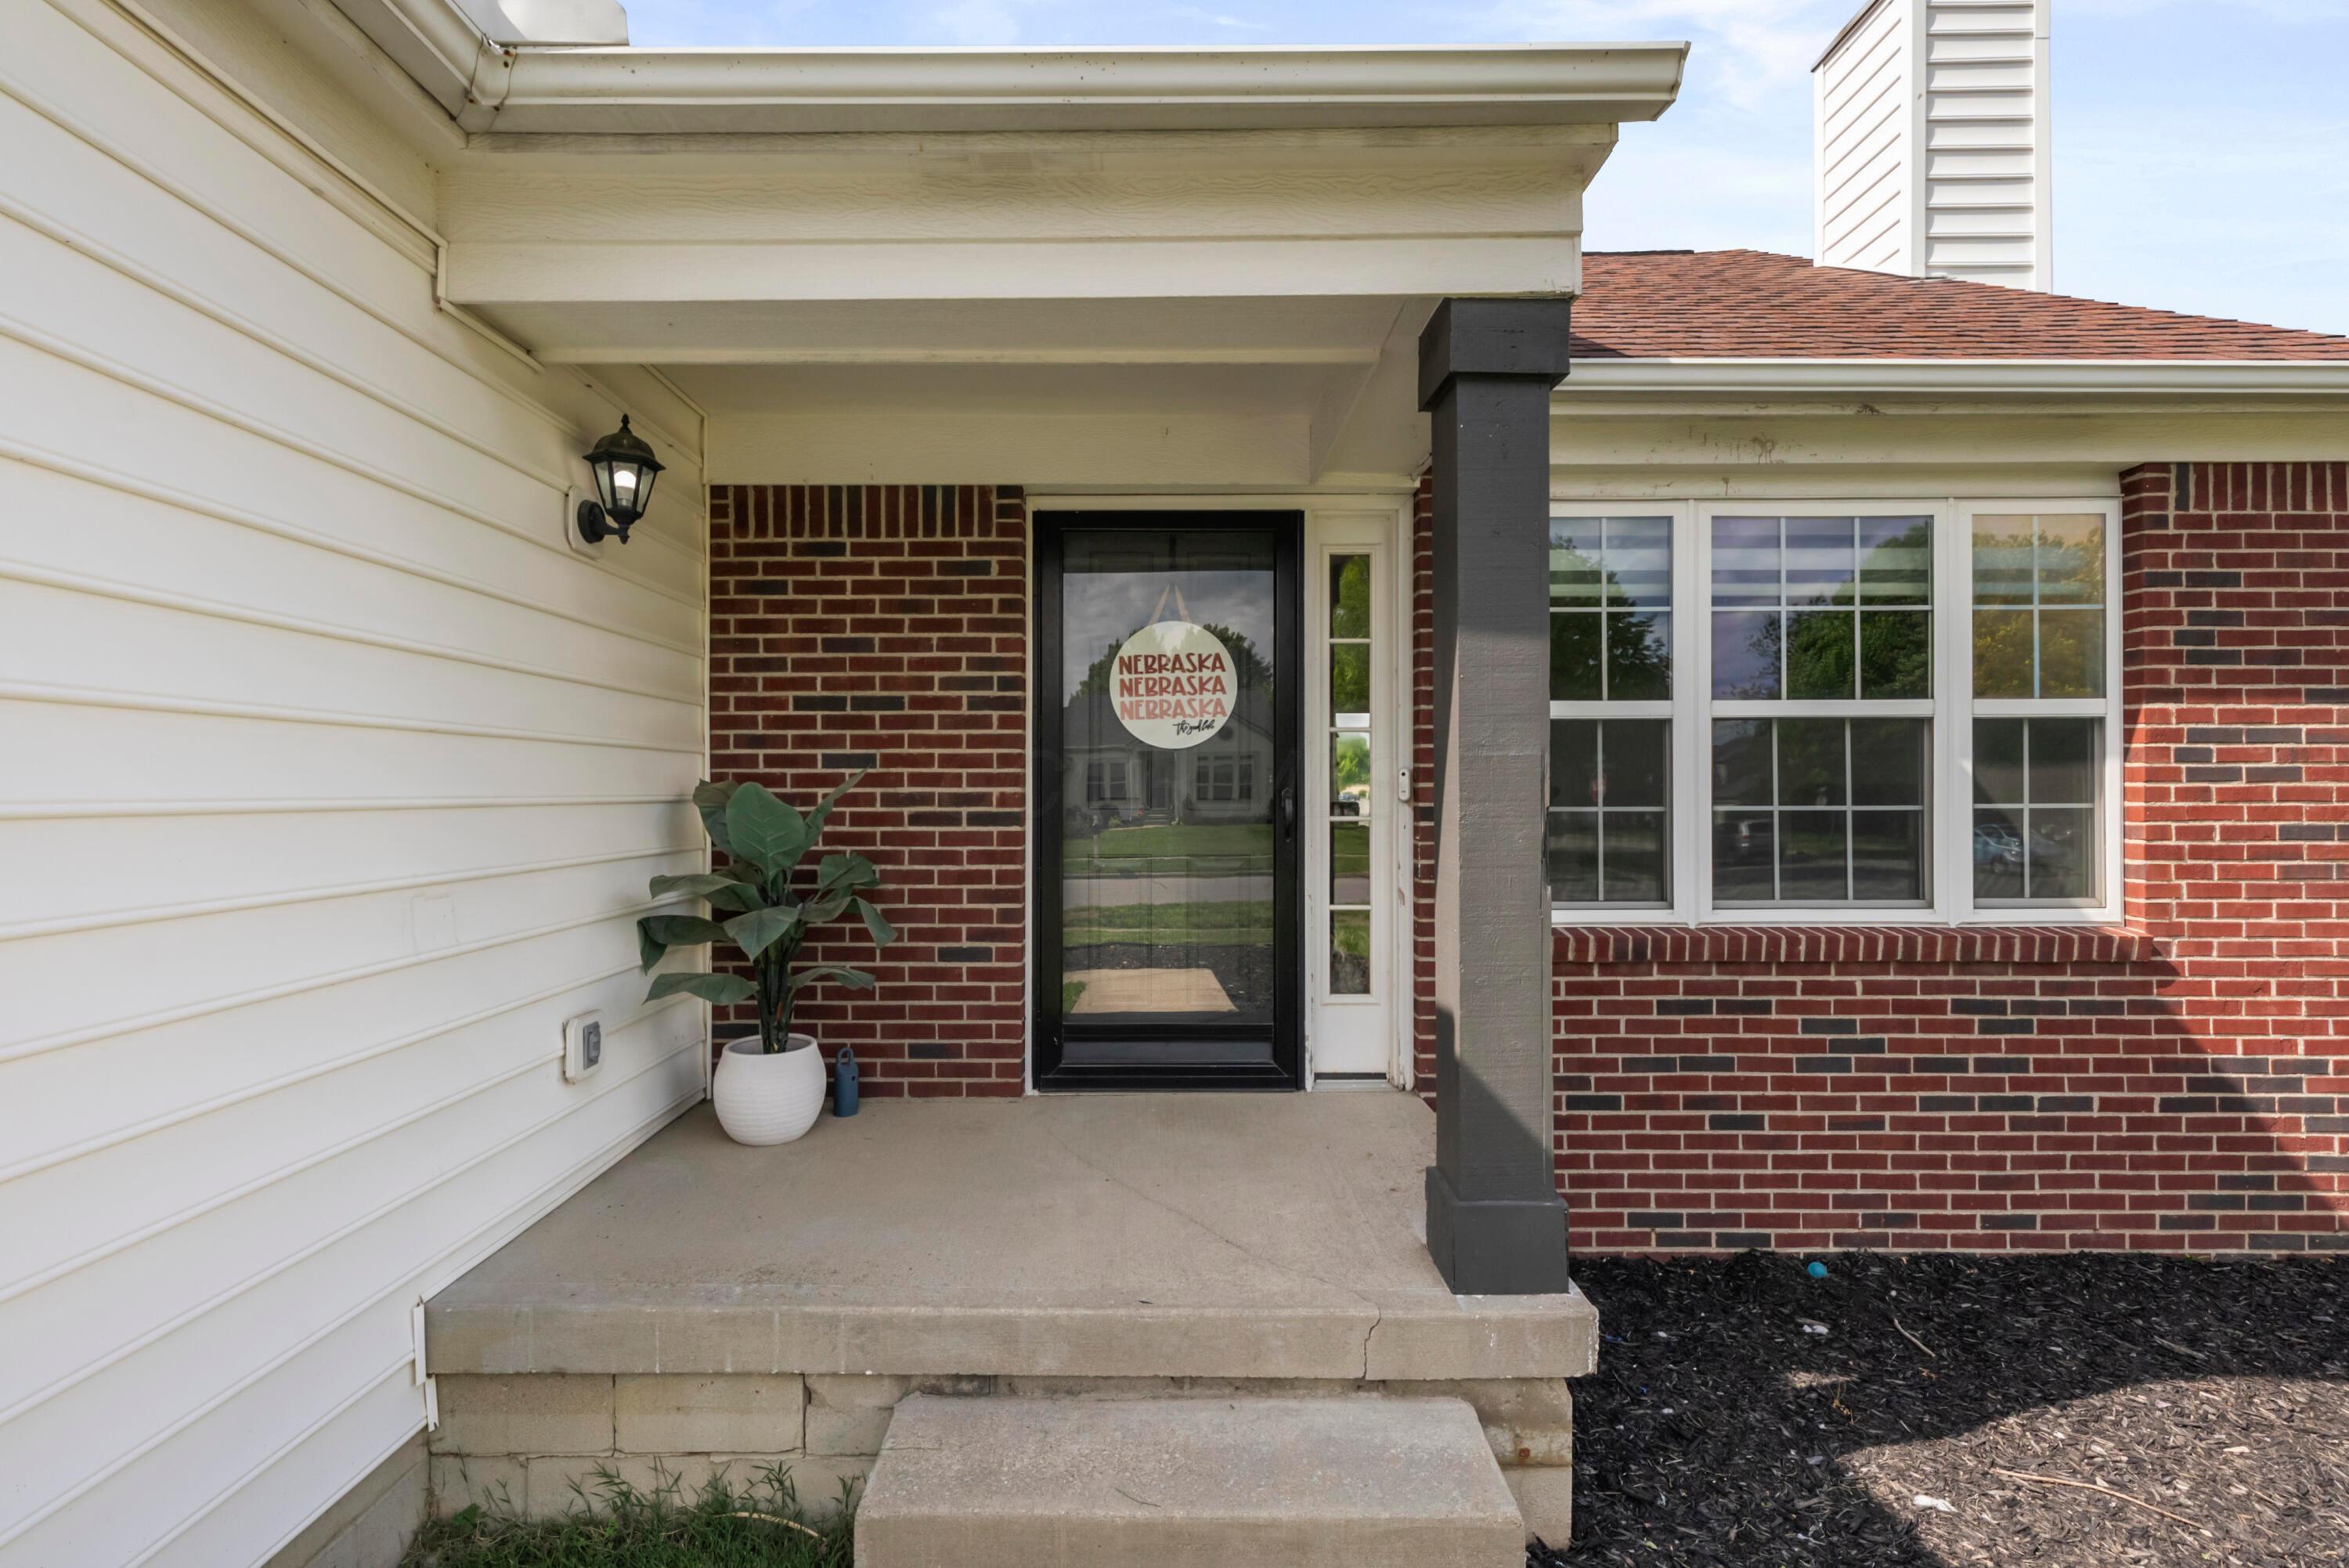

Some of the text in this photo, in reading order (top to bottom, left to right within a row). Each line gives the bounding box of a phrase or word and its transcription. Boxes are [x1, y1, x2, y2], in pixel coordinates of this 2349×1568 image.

[1119, 653, 1227, 675] NEBRASKA
[1119, 676, 1227, 697] NEBRASKA
[1120, 697, 1228, 720] NEBRASKA
